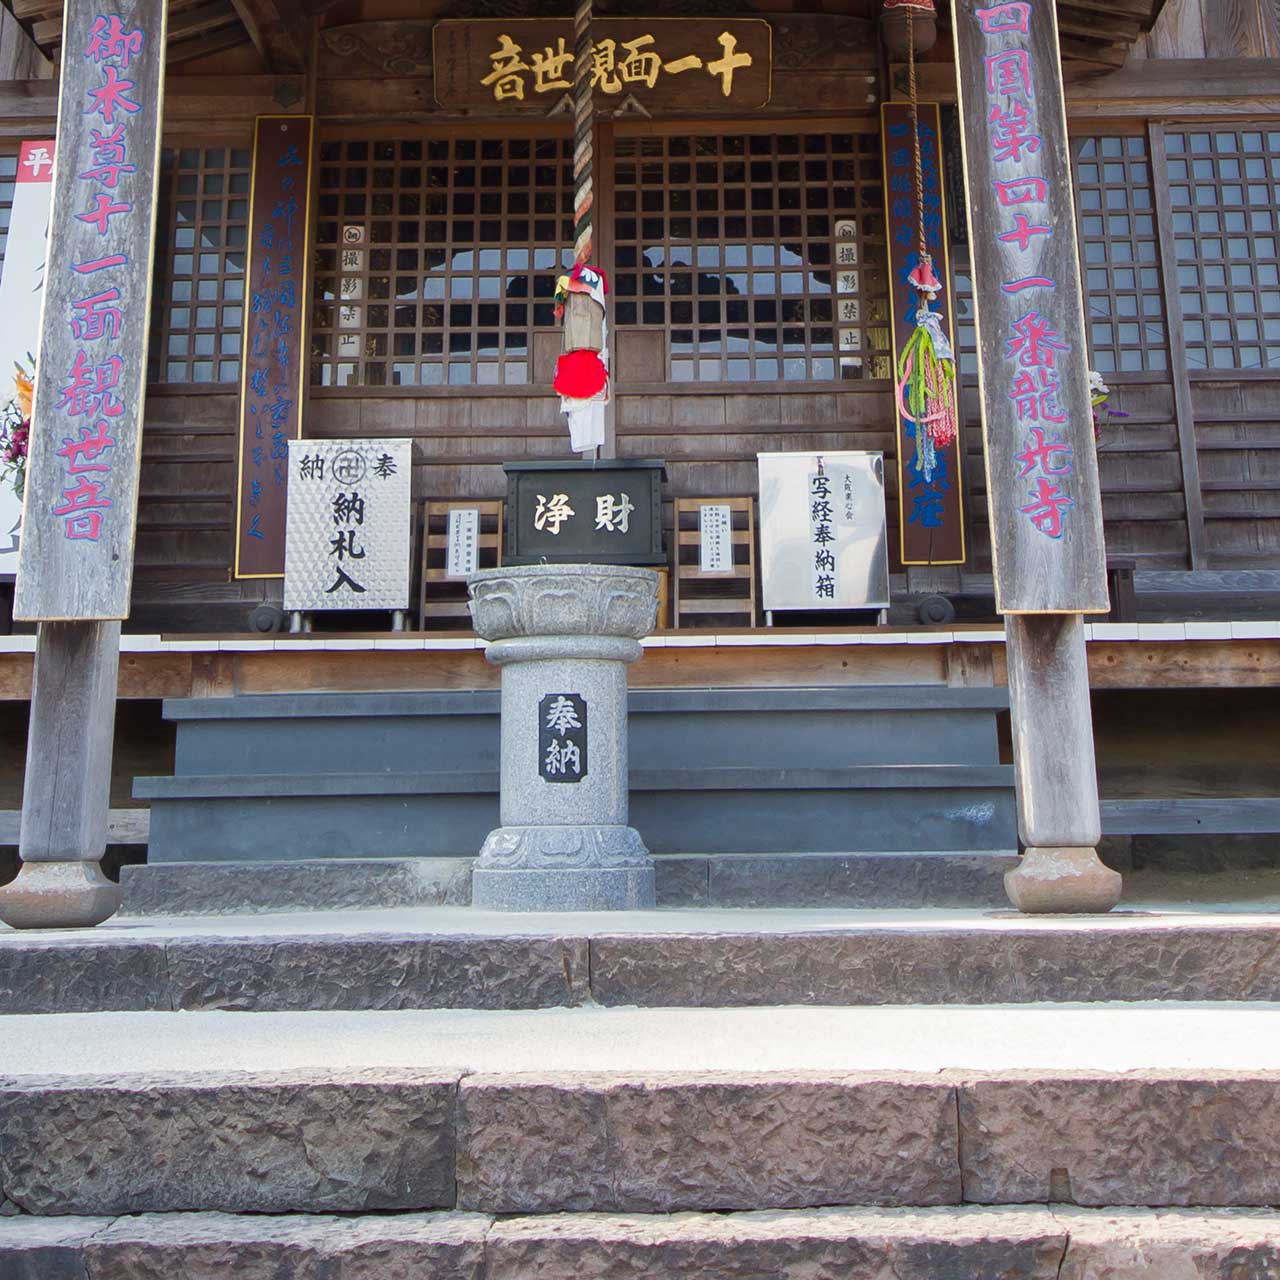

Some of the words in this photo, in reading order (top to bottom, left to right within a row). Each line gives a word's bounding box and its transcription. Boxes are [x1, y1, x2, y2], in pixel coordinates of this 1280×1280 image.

[22, 148, 54, 178] 平
[52, 14, 144, 541] 御本尊十一面観世音
[838, 247, 859, 345] 撮影禁止
[975, 1, 1075, 540] 四国第四十一番龍光寺
[299, 455, 325, 481] 納
[373, 453, 397, 481] 奉
[325, 492, 367, 593] 納札入
[534, 492, 636, 534] 浄財
[811, 477, 835, 598] 写経奉納箱
[545, 695, 582, 774] 奉納
